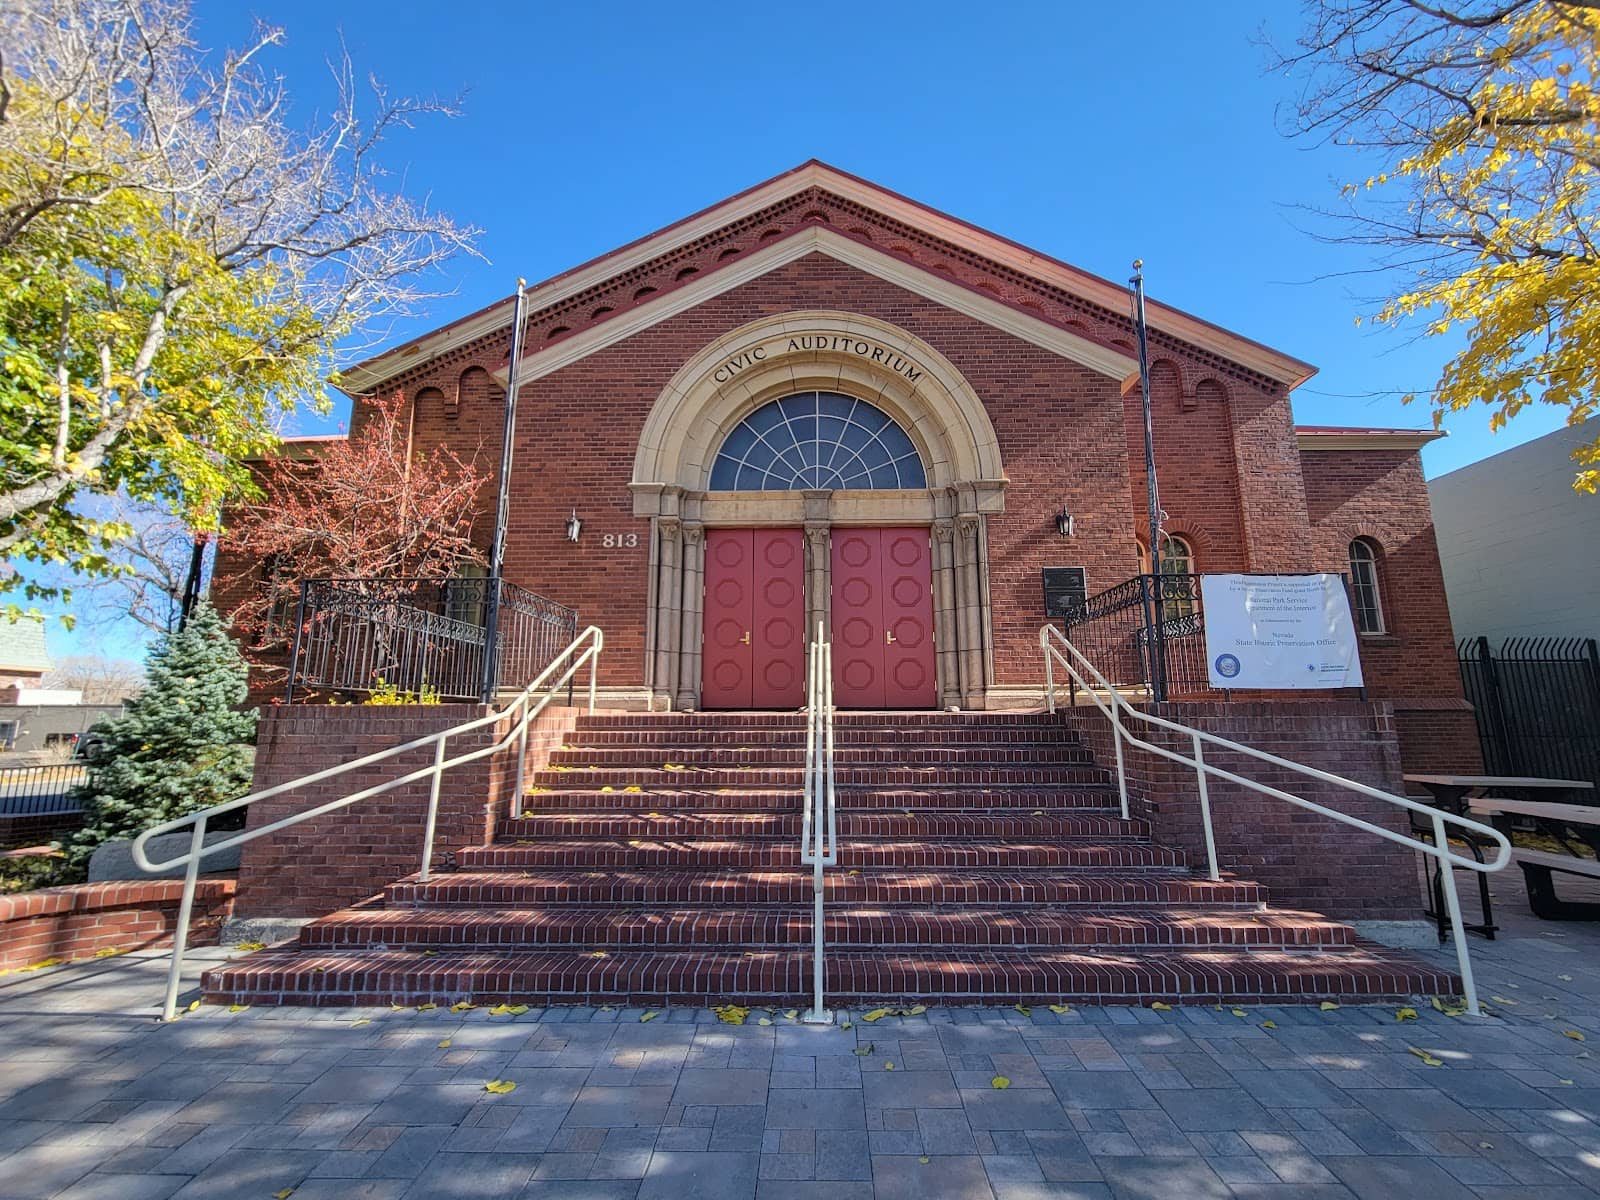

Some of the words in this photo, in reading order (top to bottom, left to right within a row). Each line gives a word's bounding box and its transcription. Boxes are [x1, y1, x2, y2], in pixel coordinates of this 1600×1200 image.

[714, 347, 768, 384] CIVIC
[787, 336, 923, 382] AUDITORIUM
[602, 533, 637, 548] 813
